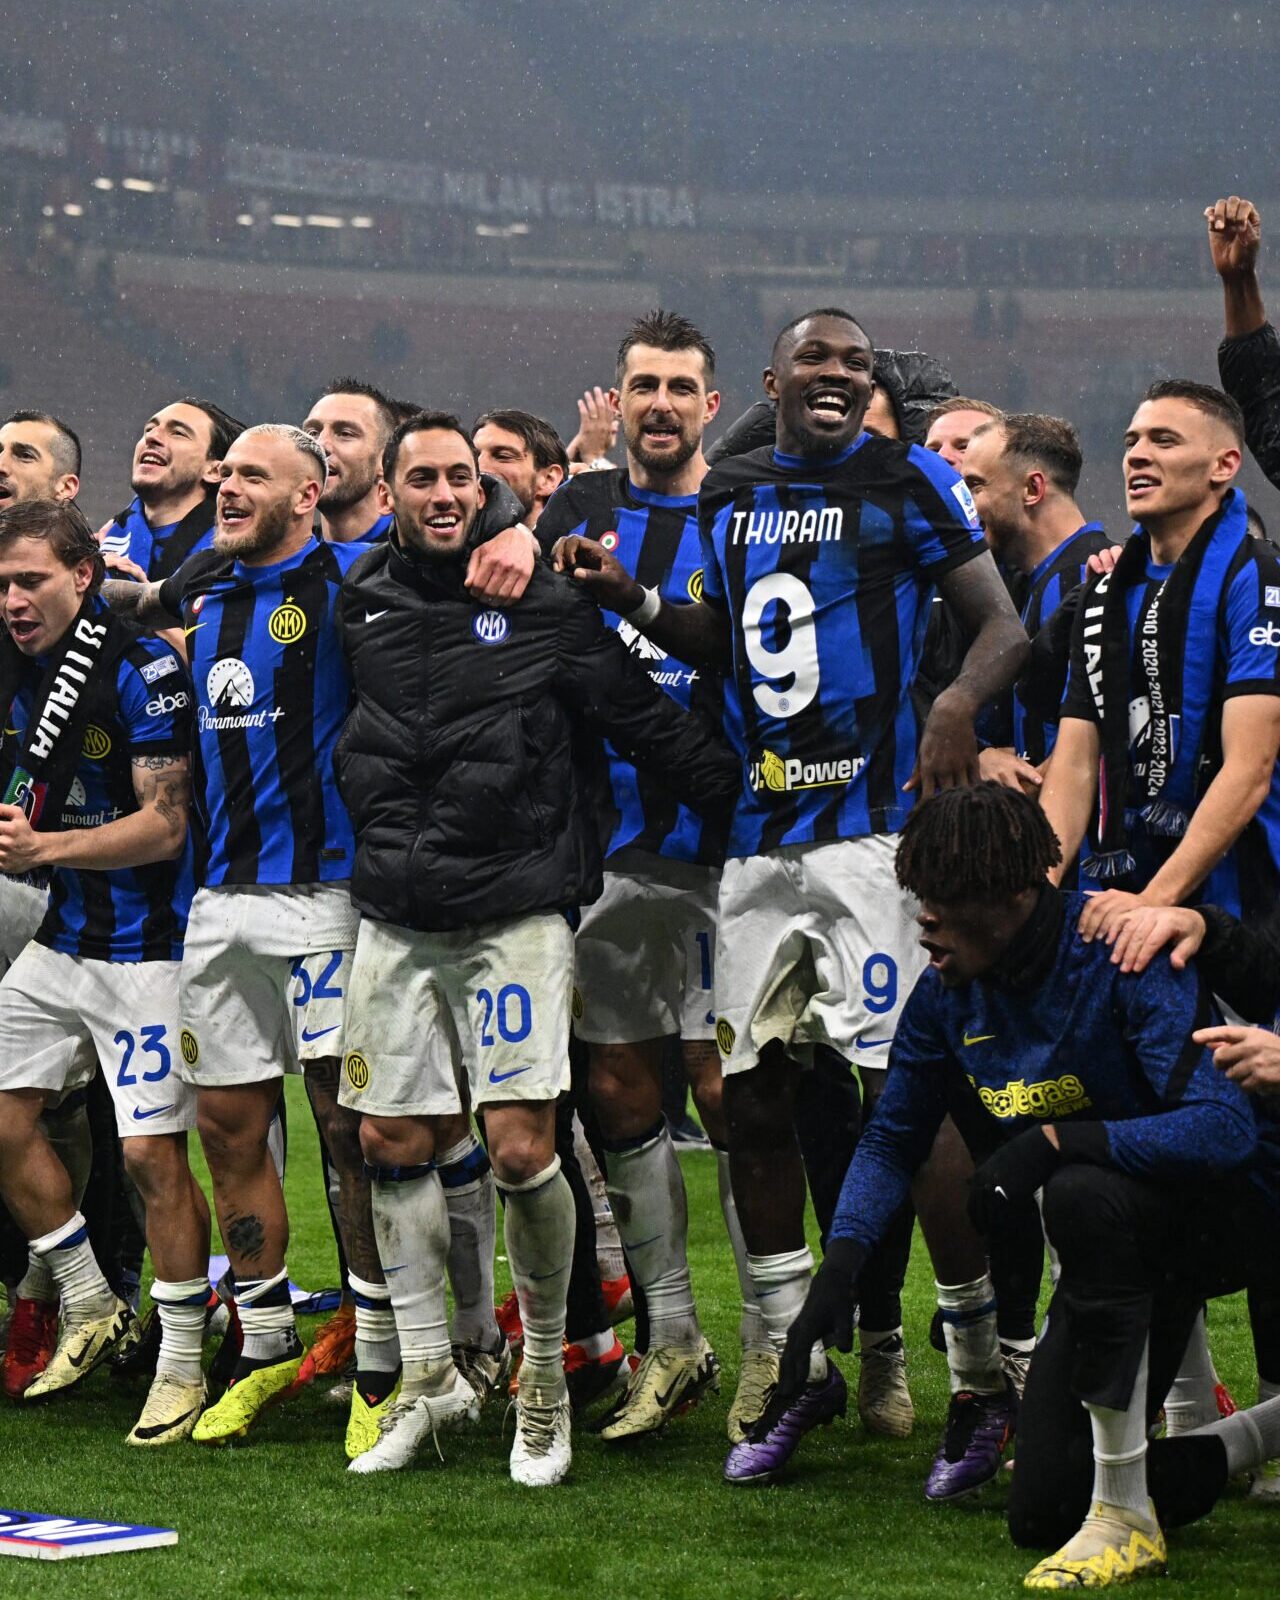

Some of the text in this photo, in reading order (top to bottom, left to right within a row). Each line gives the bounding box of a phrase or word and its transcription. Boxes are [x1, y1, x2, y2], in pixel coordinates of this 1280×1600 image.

[732, 506, 844, 545] THURAM
[143, 664, 158, 680] 23
[742, 572, 820, 719] 9
[1141, 638, 1165, 716] 2020-2021
[1147, 718, 1167, 797] 2023-2024
[287, 950, 343, 1008] 32
[862, 953, 898, 1014] 9
[476, 983, 532, 1048] 20
[113, 1024, 172, 1088] 23
